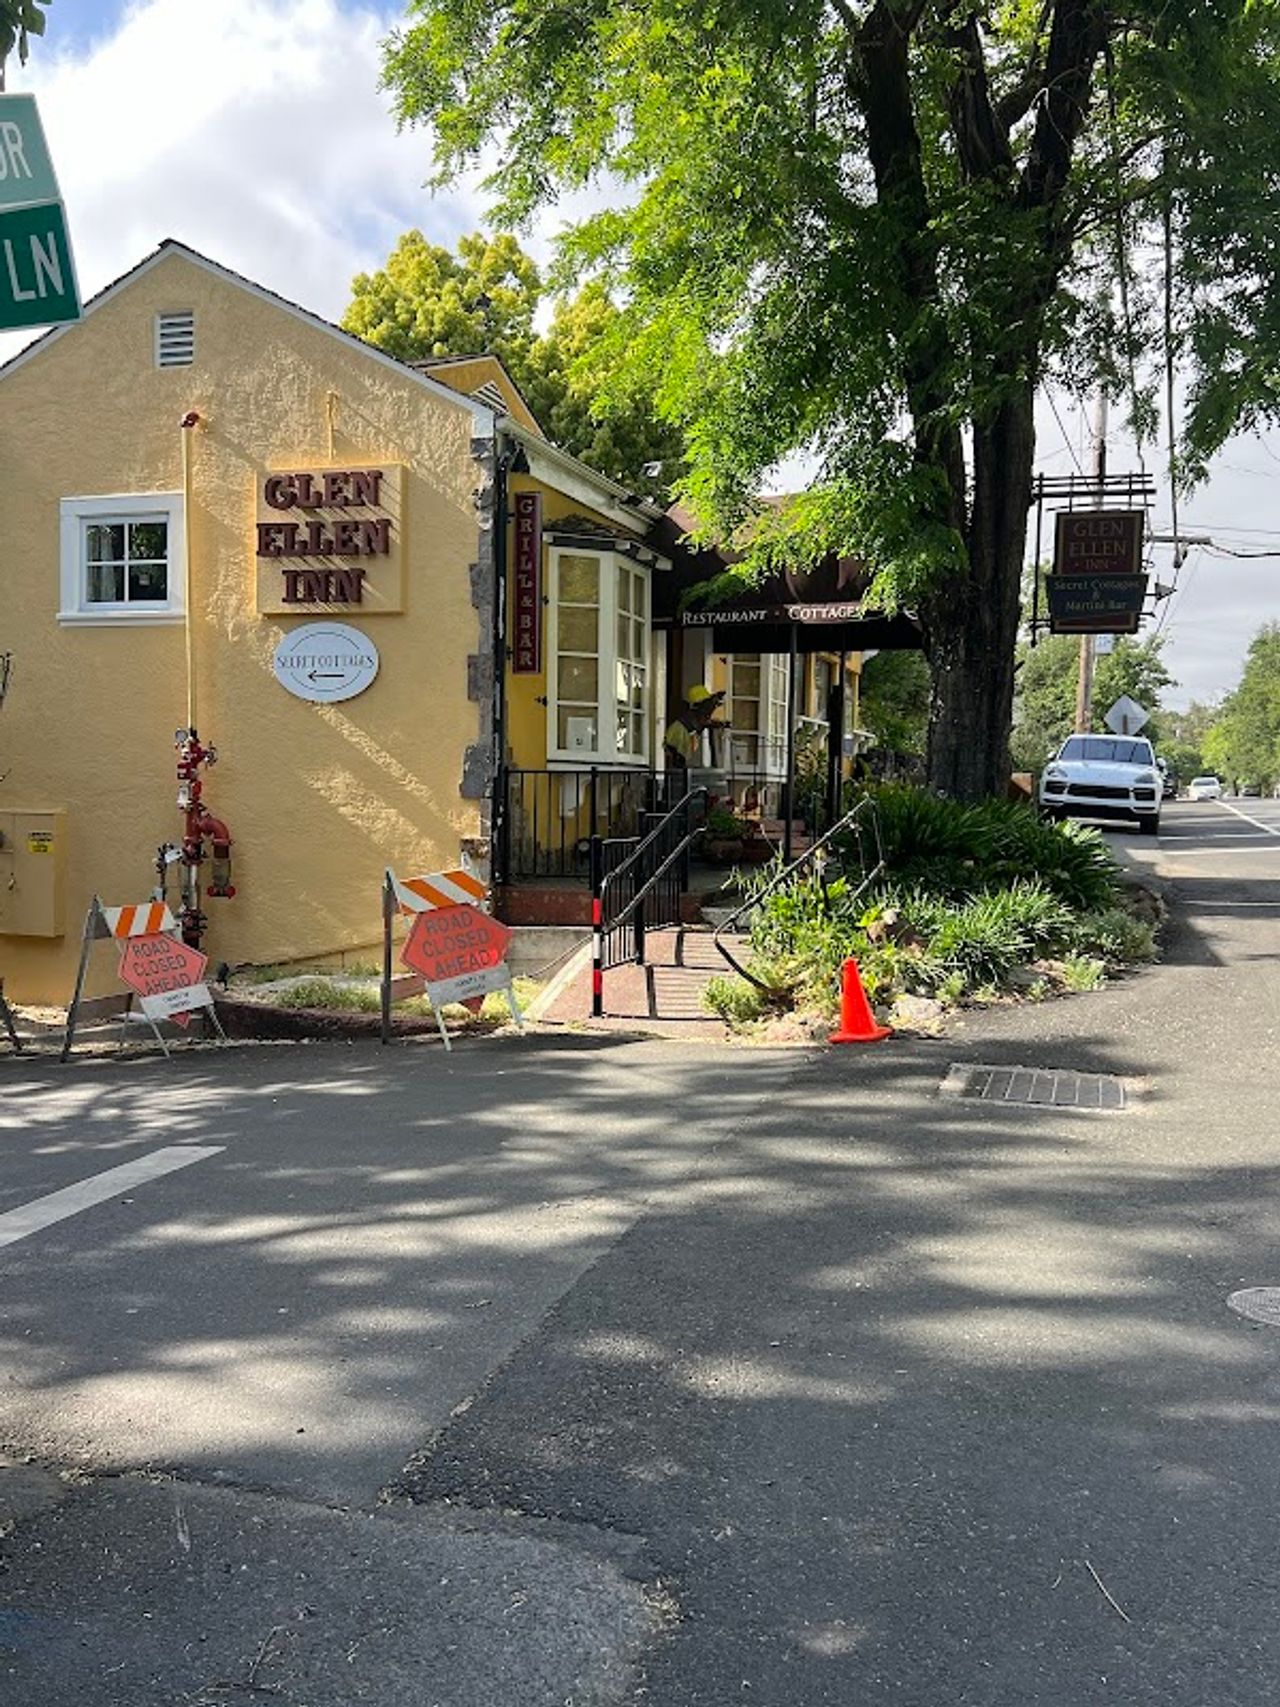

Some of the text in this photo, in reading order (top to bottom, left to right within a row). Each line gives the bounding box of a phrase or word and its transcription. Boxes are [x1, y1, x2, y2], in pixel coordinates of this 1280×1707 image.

[4, 231, 65, 302] LN
[265, 470, 382, 510] GLEN
[256, 518, 392, 557] ELLEN
[1073, 520, 1124, 537] GLEN
[519, 499, 534, 589] GRILL
[1069, 539, 1127, 558] ELLEN
[1086, 559, 1109, 570] INN
[281, 567, 366, 603] INN
[519, 614, 533, 665] BAR
[425, 911, 474, 934] ROAD
[132, 940, 170, 958] ROAD
[421, 928, 491, 958] CLOSED
[132, 954, 187, 976] CLOSED
[434, 950, 491, 978] AHEAD
[144, 972, 192, 996] AHEAD
